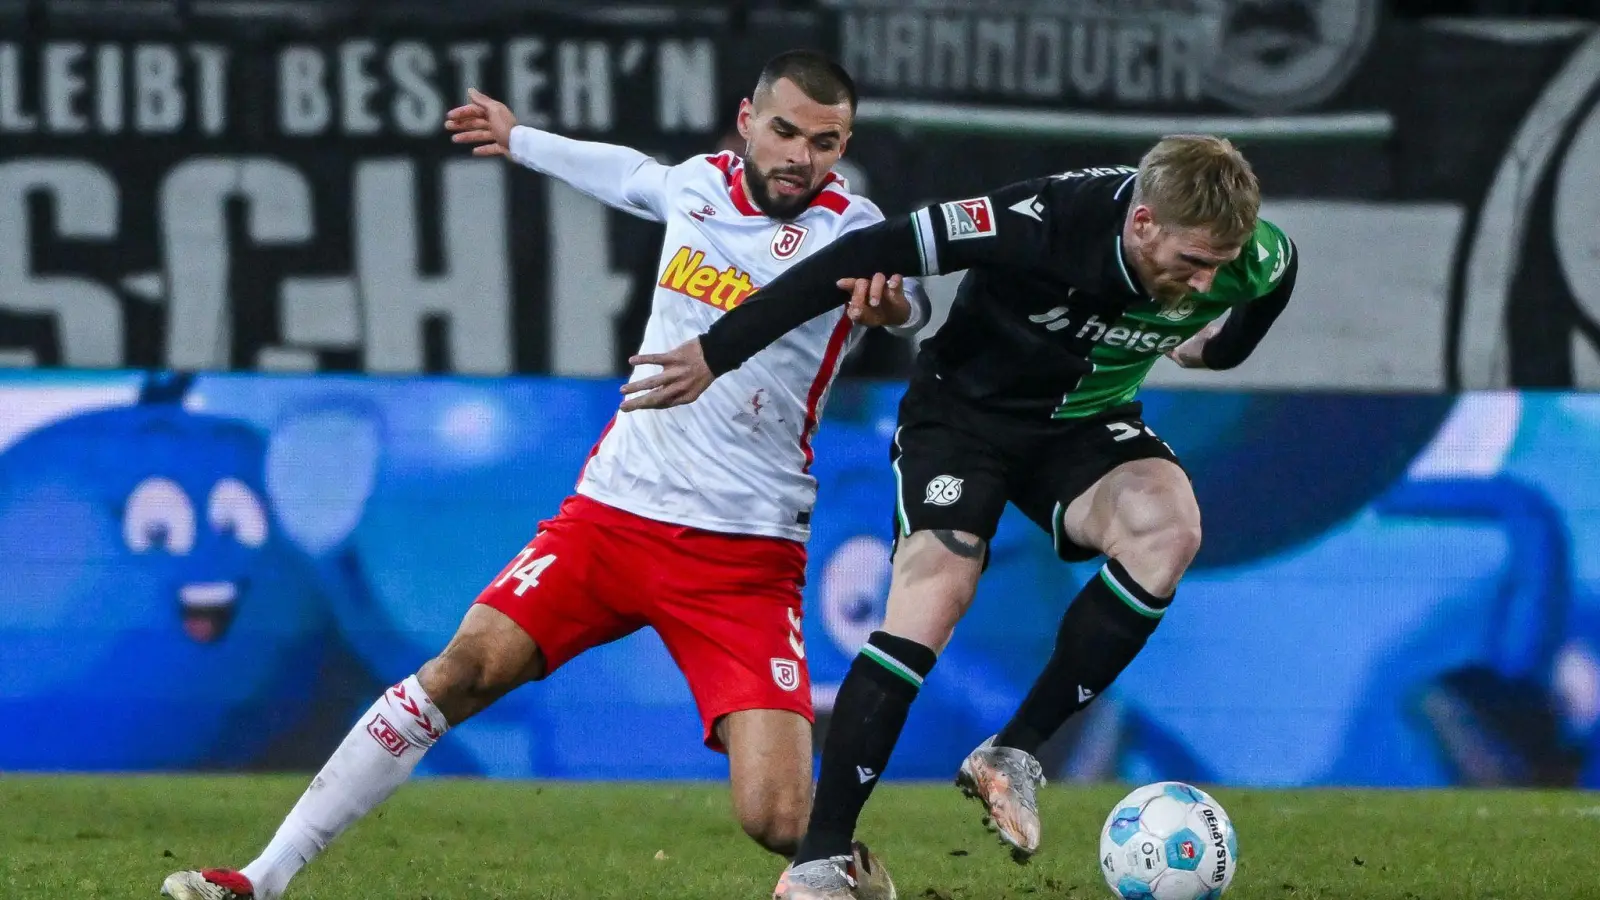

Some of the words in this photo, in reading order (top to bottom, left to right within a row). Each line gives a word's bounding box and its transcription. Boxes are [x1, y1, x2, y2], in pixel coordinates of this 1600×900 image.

[659, 246, 760, 311] Nett
[1076, 314, 1182, 352] heise
[924, 476, 964, 504] 96
[494, 547, 557, 597] 14
[1203, 809, 1227, 883] DERBYSTAR
